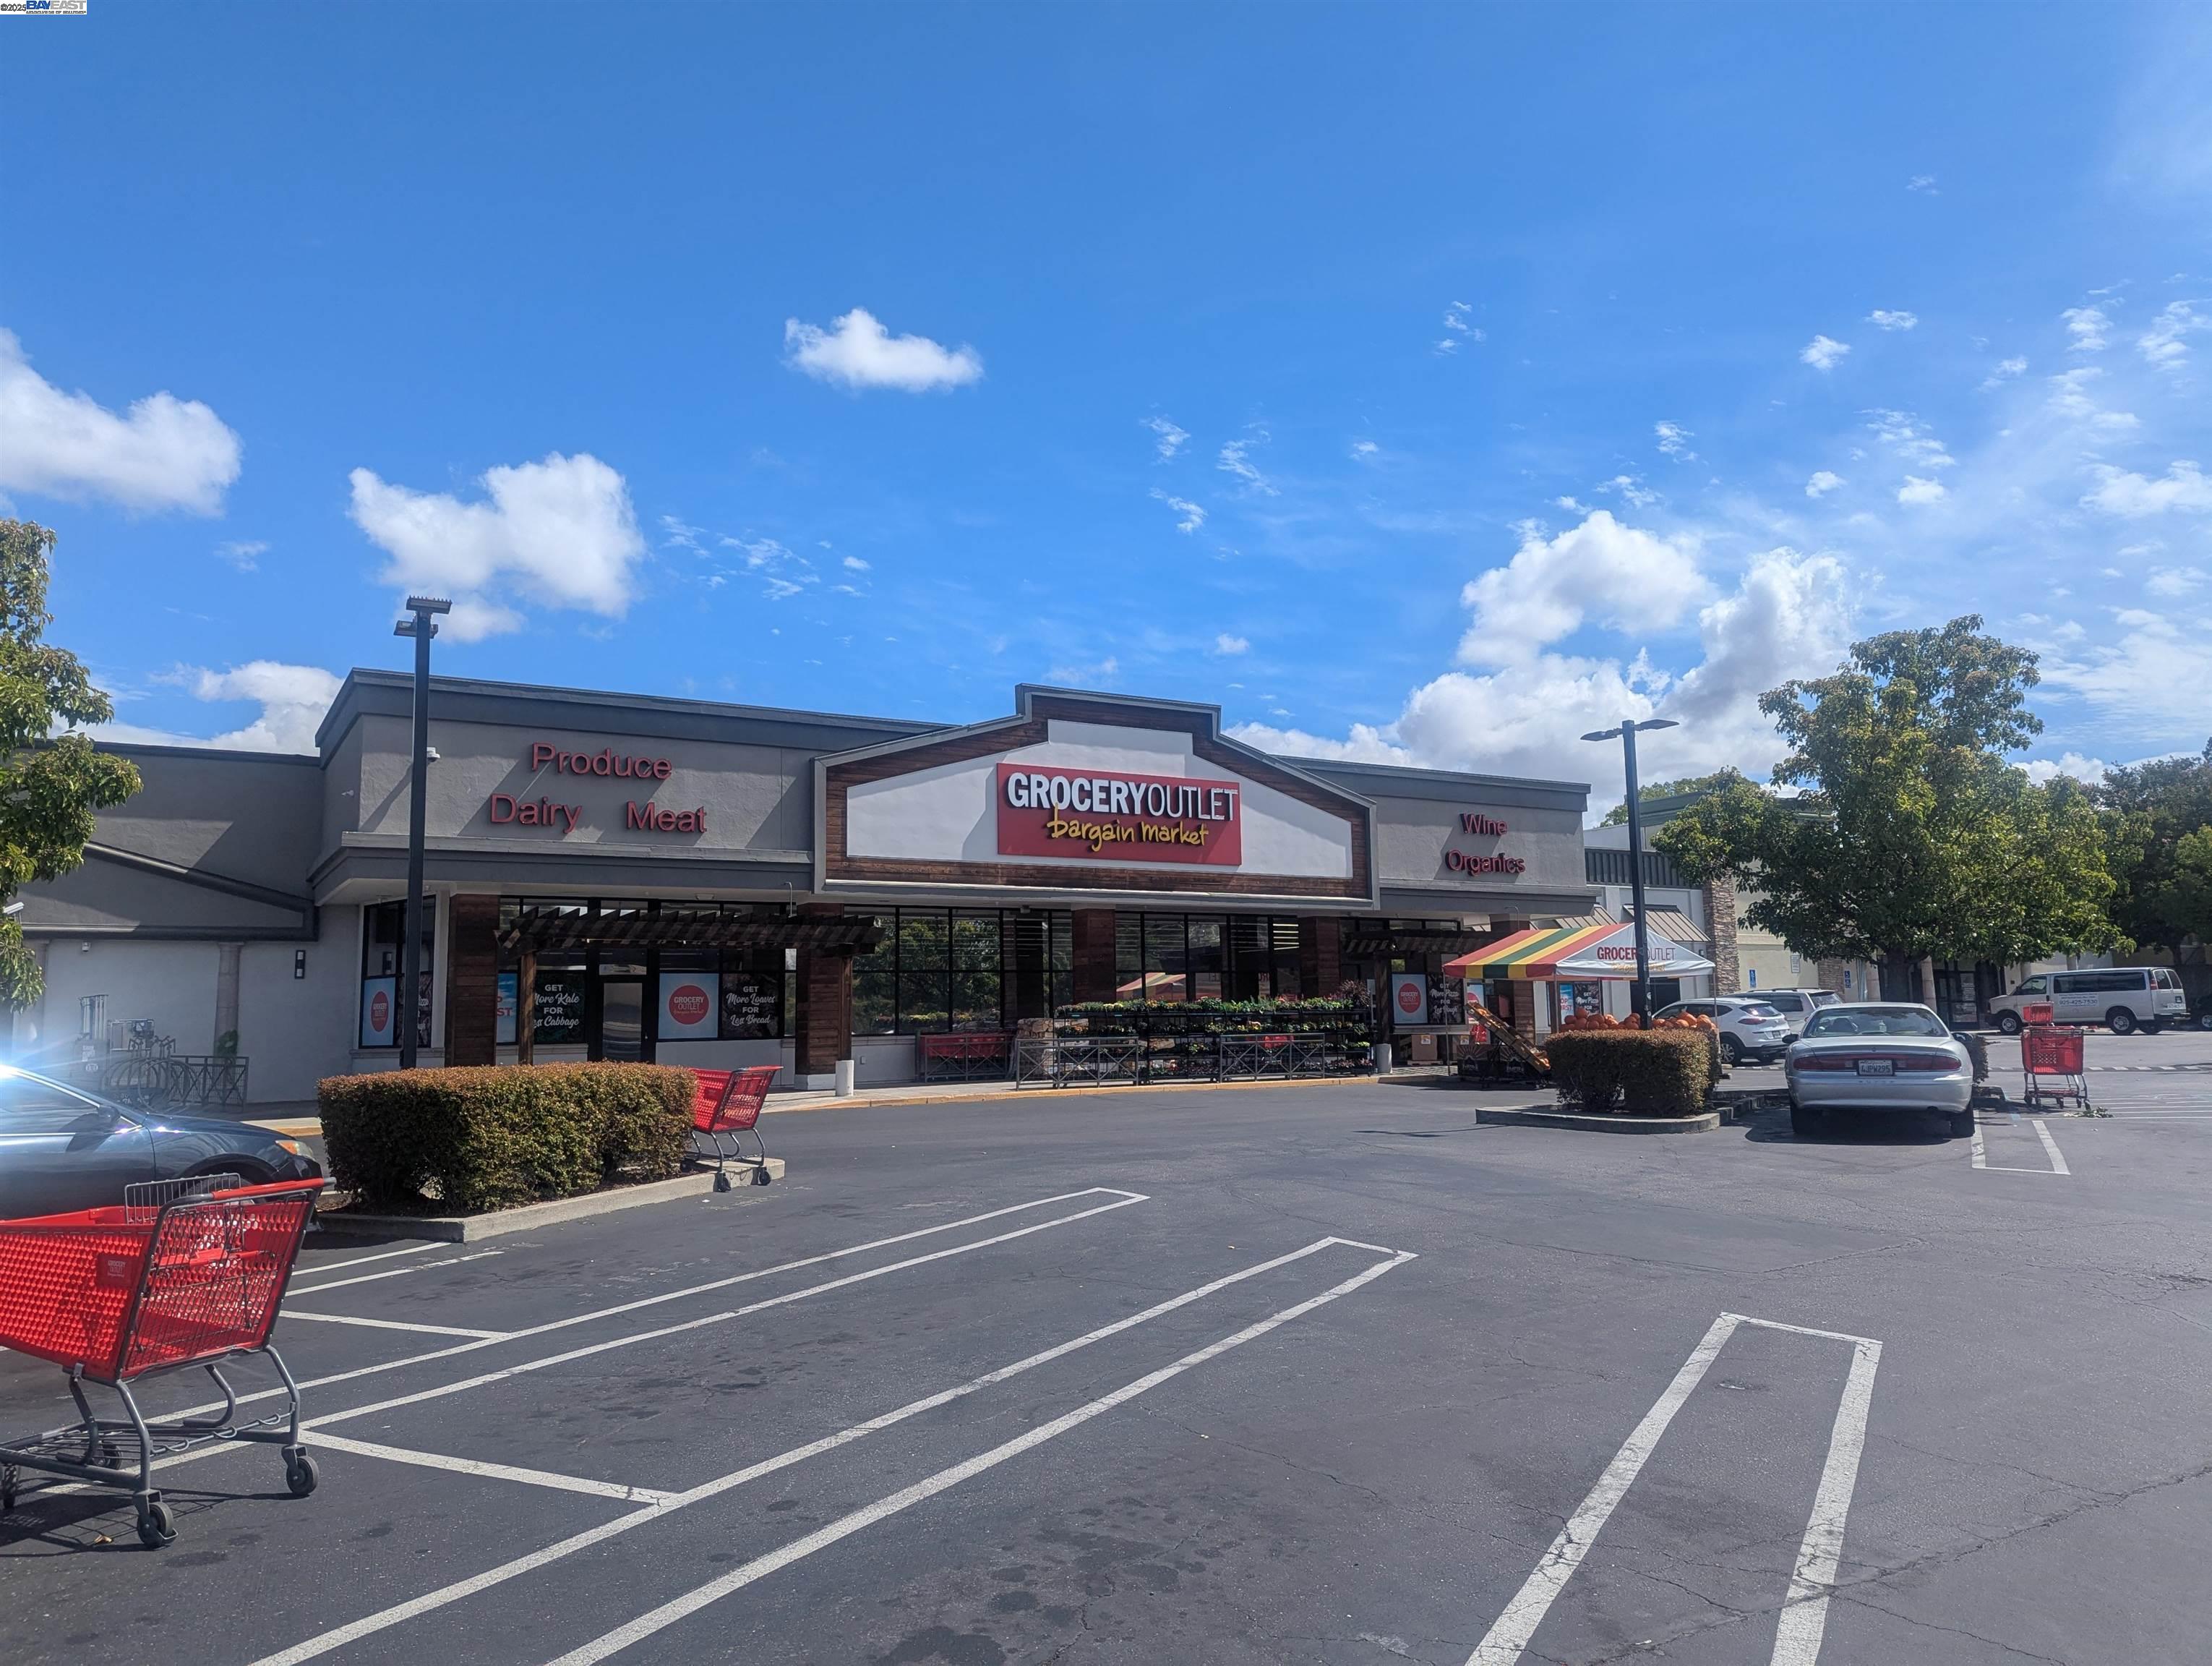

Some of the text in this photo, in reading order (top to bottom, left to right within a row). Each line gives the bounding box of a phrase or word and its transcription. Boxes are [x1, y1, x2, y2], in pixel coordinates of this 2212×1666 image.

[531, 741, 673, 779] Produce
[490, 793, 708, 834] Dairy Meat
[1046, 801, 1209, 852] bargain market
[1459, 813, 1508, 836] Wine
[1445, 849, 1526, 876] Organics
[1597, 946, 1637, 961] GROCER
[554, 993, 580, 1005] Kale
[726, 992, 750, 1005] More
[544, 1015, 579, 1029] Cabbage
[745, 1014, 771, 1025] Bread
